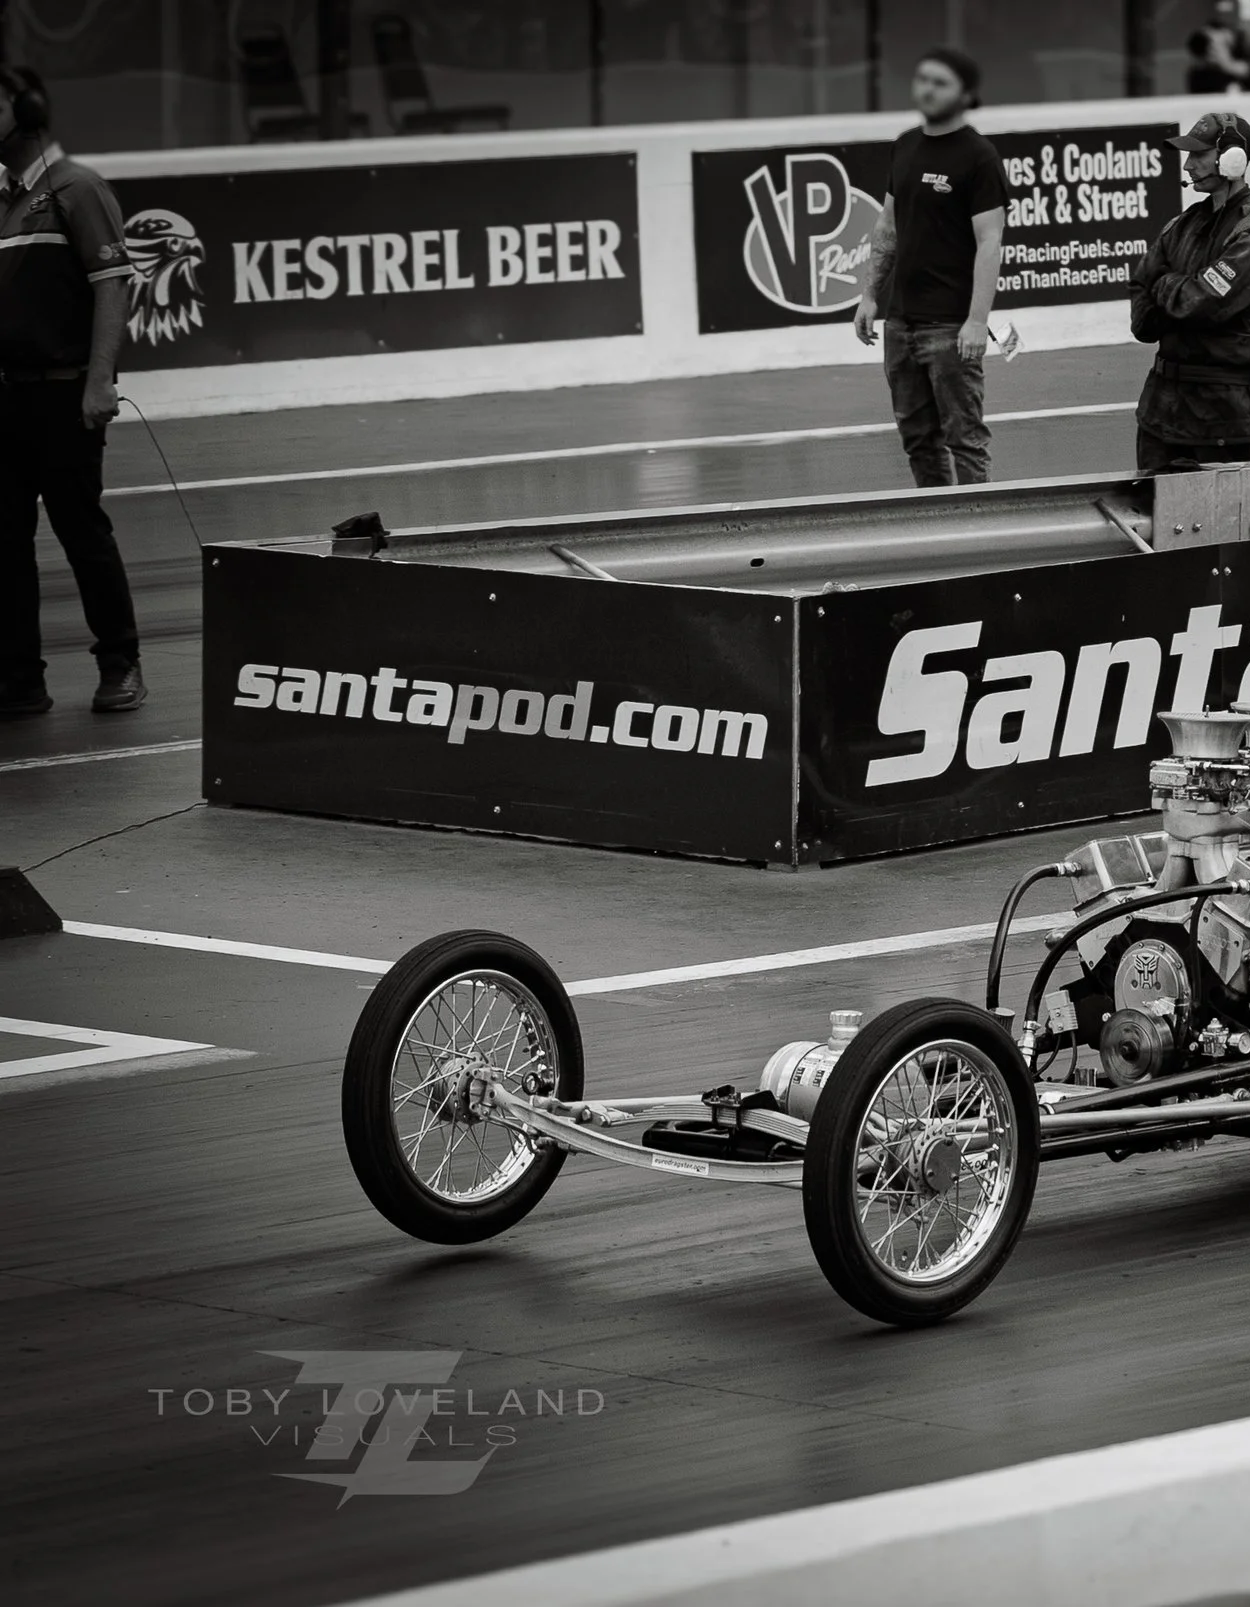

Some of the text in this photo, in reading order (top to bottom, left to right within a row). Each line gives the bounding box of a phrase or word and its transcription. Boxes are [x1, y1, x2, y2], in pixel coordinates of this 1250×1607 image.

[1041, 145, 1058, 184] &
[1063, 141, 1163, 183] Coolants
[1055, 185, 1072, 224] &
[1077, 182, 1149, 222] Street
[743, 153, 850, 308] VP
[232, 219, 625, 303] KESTREL BEER
[817, 233, 871, 292] Racin
[996, 263, 1131, 291] oreThanRaceFuel
[233, 663, 768, 760] santapod.com
[654, 1157, 707, 1173] eurodragster.com
